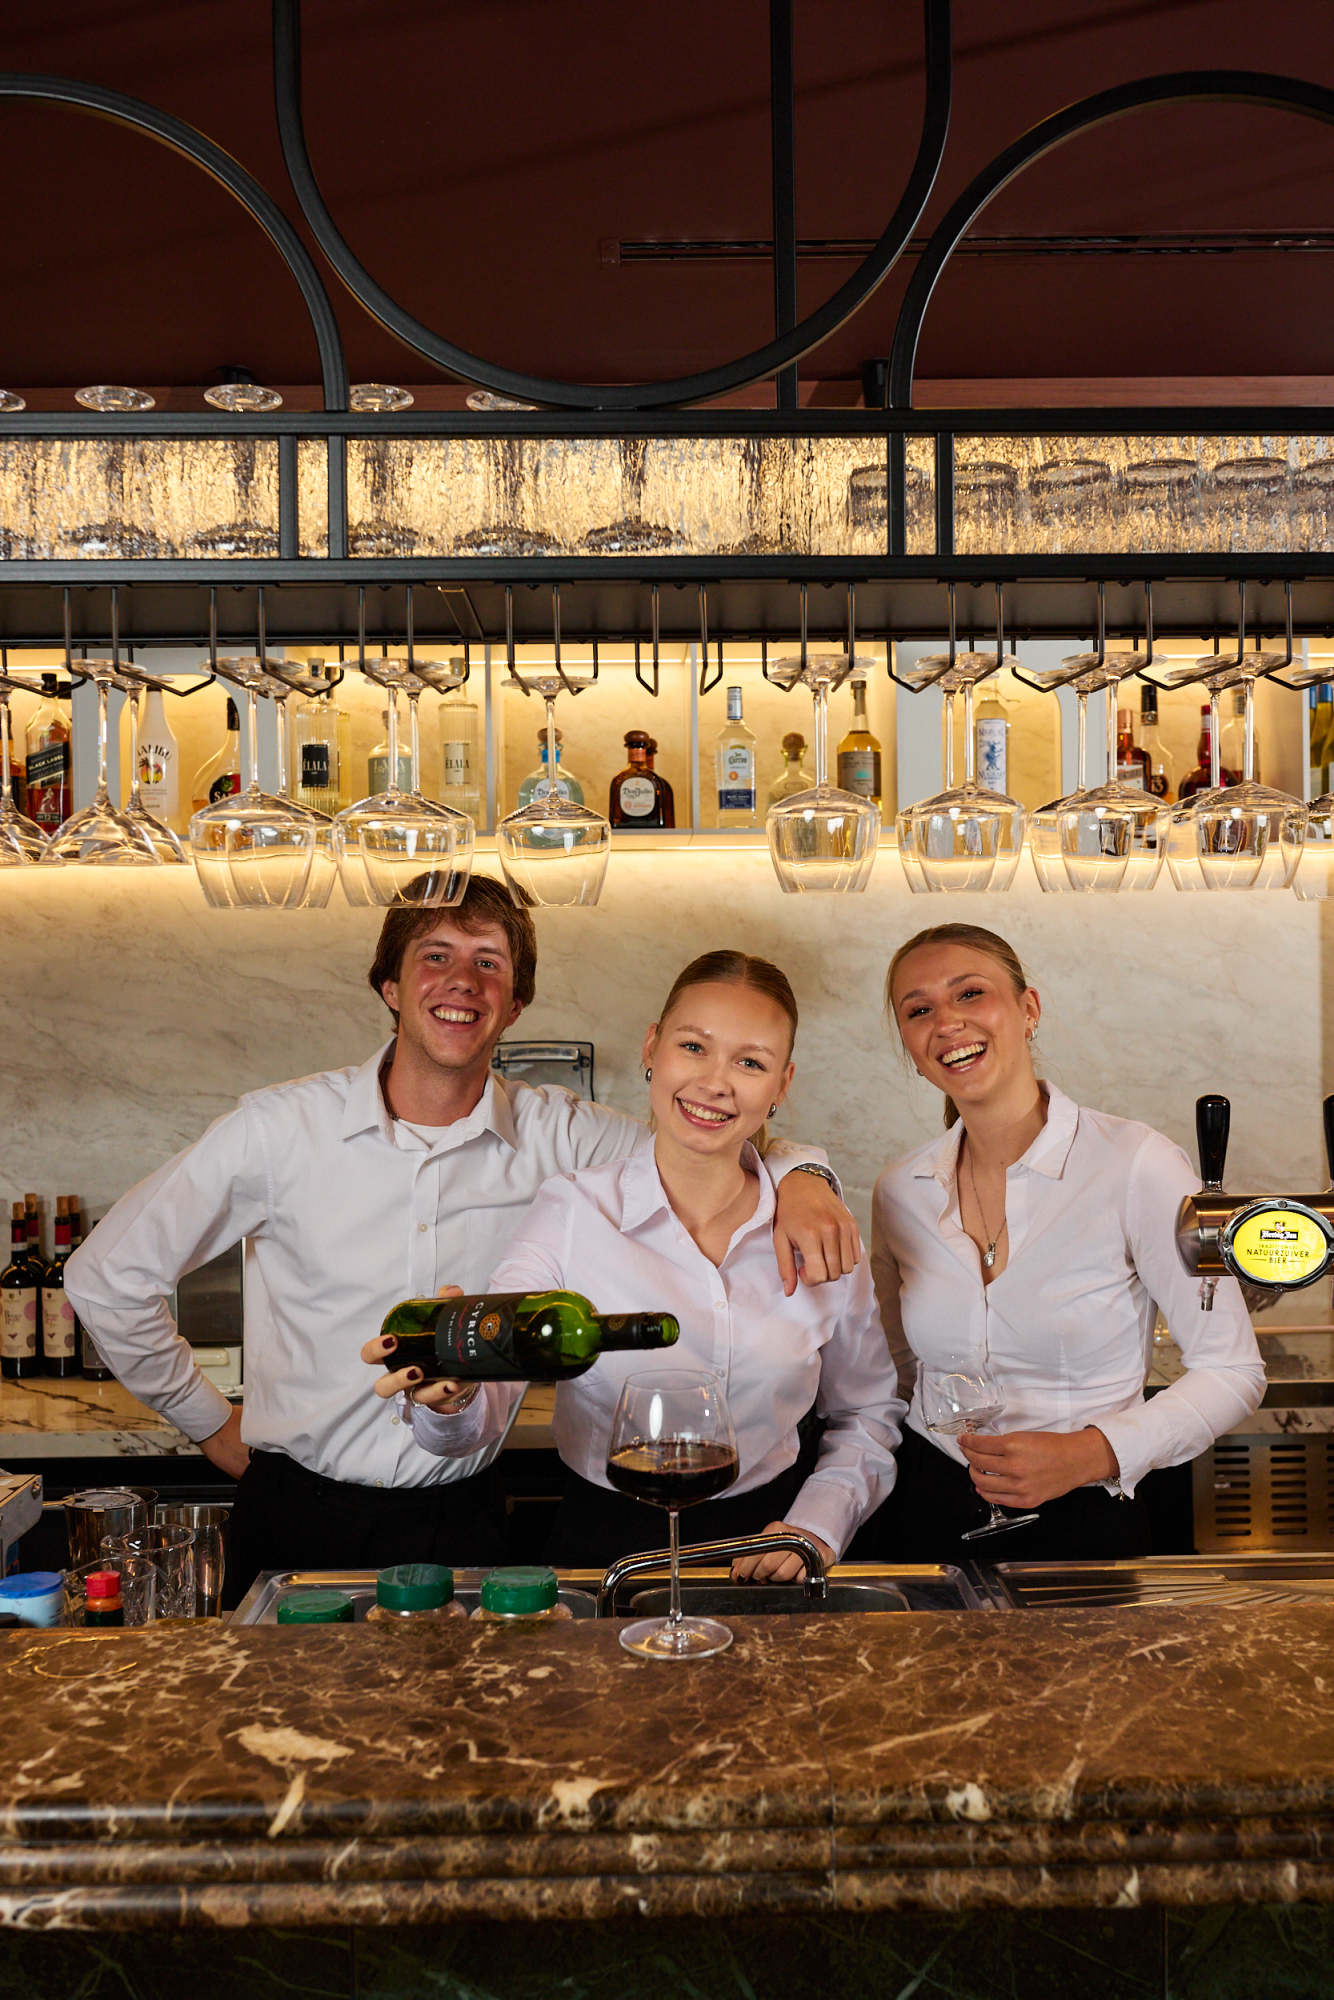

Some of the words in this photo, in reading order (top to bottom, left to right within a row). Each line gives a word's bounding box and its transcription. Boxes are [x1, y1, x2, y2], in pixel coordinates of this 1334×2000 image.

[28, 759, 46, 771] BLACK
[46, 754, 64, 765] LABEL
[1261, 1230, 1284, 1239] Hertog
[1284, 1231, 1297, 1241] Jan
[1246, 1249, 1309, 1258] NATUURZUIVER
[467, 1302, 484, 1357] CYRICE
